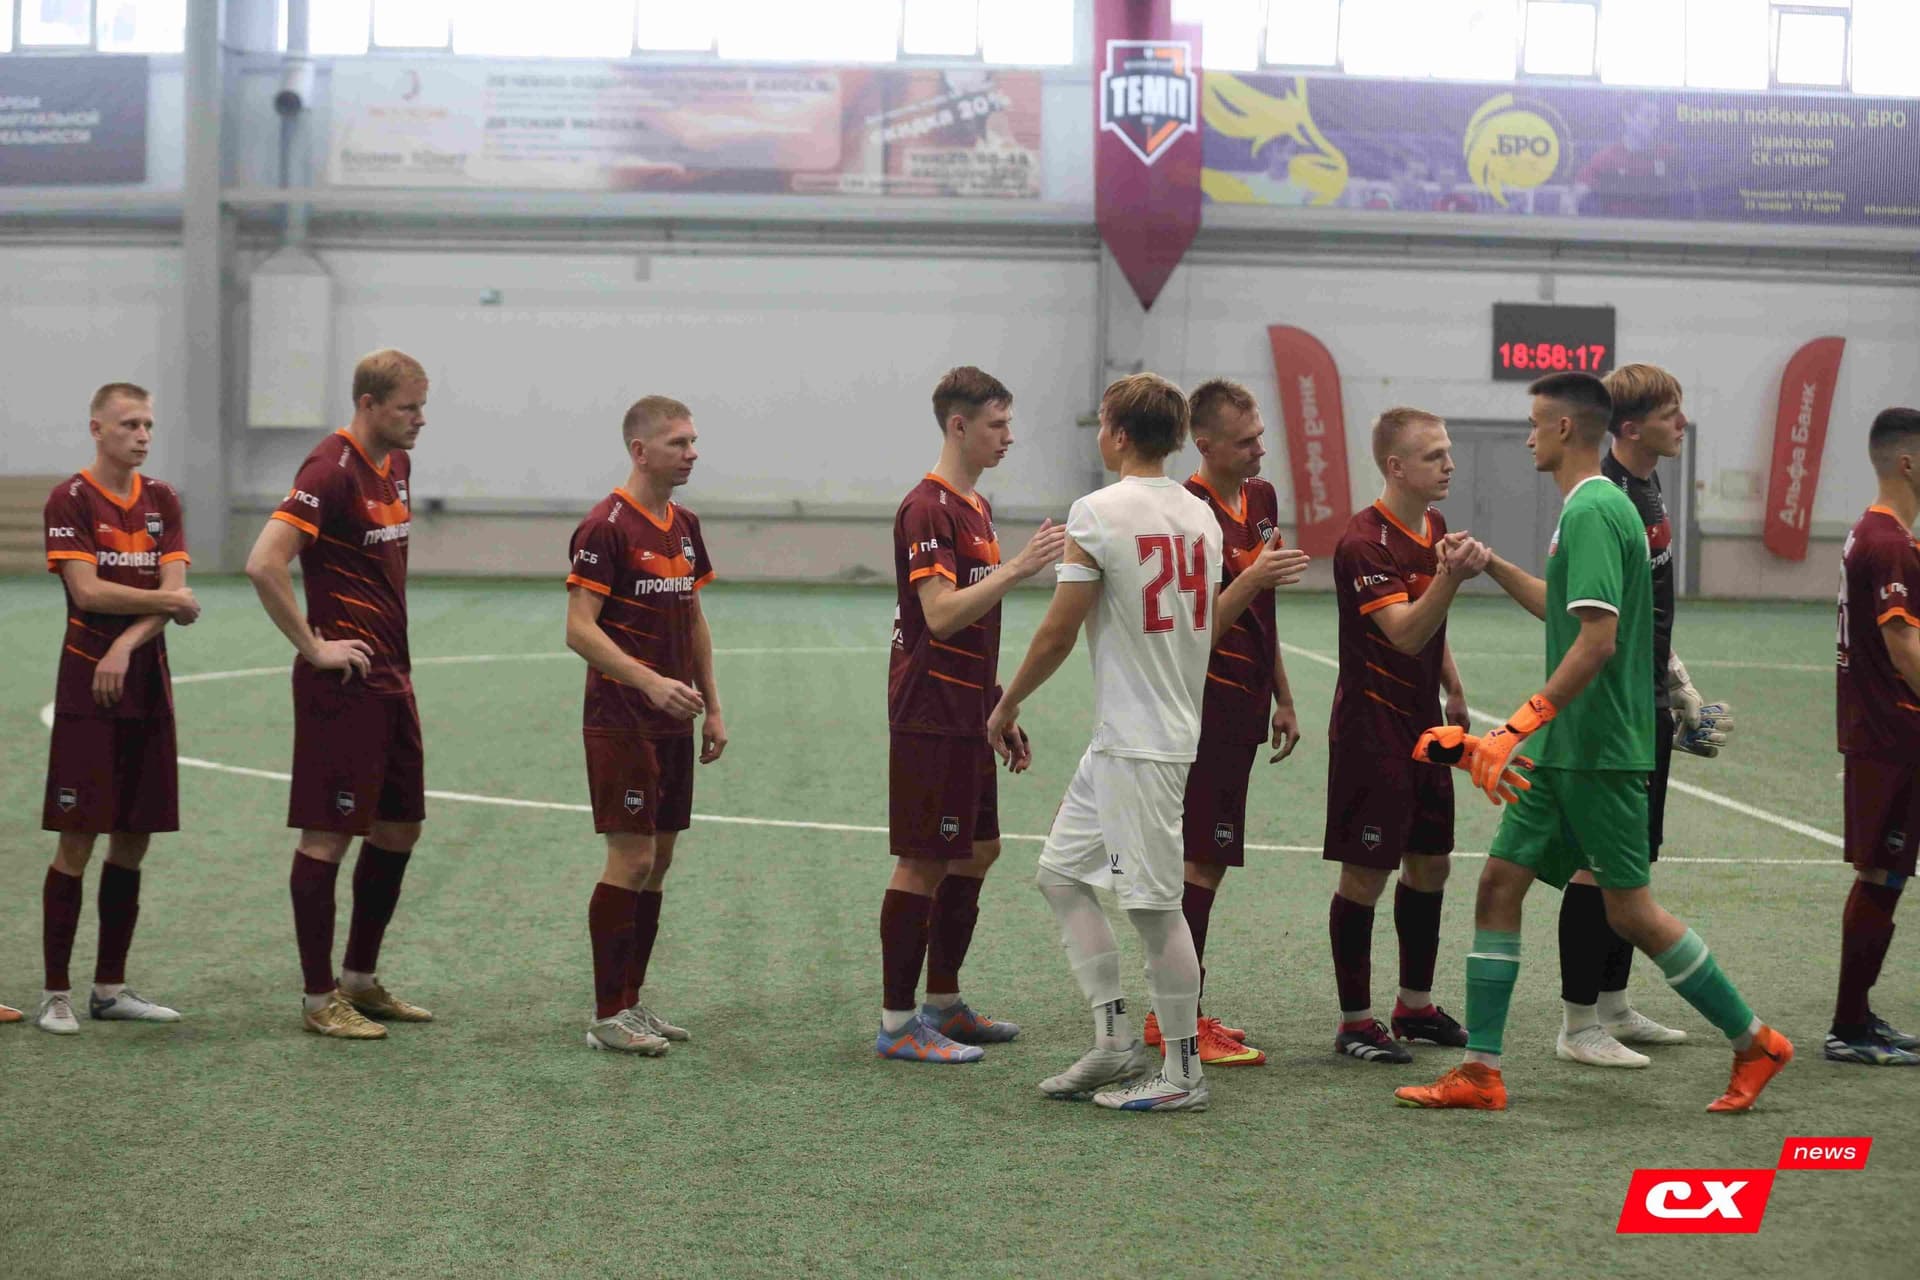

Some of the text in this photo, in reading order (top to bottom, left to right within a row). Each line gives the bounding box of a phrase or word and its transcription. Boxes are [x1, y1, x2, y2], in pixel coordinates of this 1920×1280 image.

[1109, 74, 1188, 119] ТЕМП
[1676, 103, 1739, 125] Время
[1490, 133, 1552, 157] .БРО
[1499, 342, 1606, 370] 18:58:17
[1779, 383, 1817, 529] Альфа Банк
[1135, 533, 1209, 633] 24
